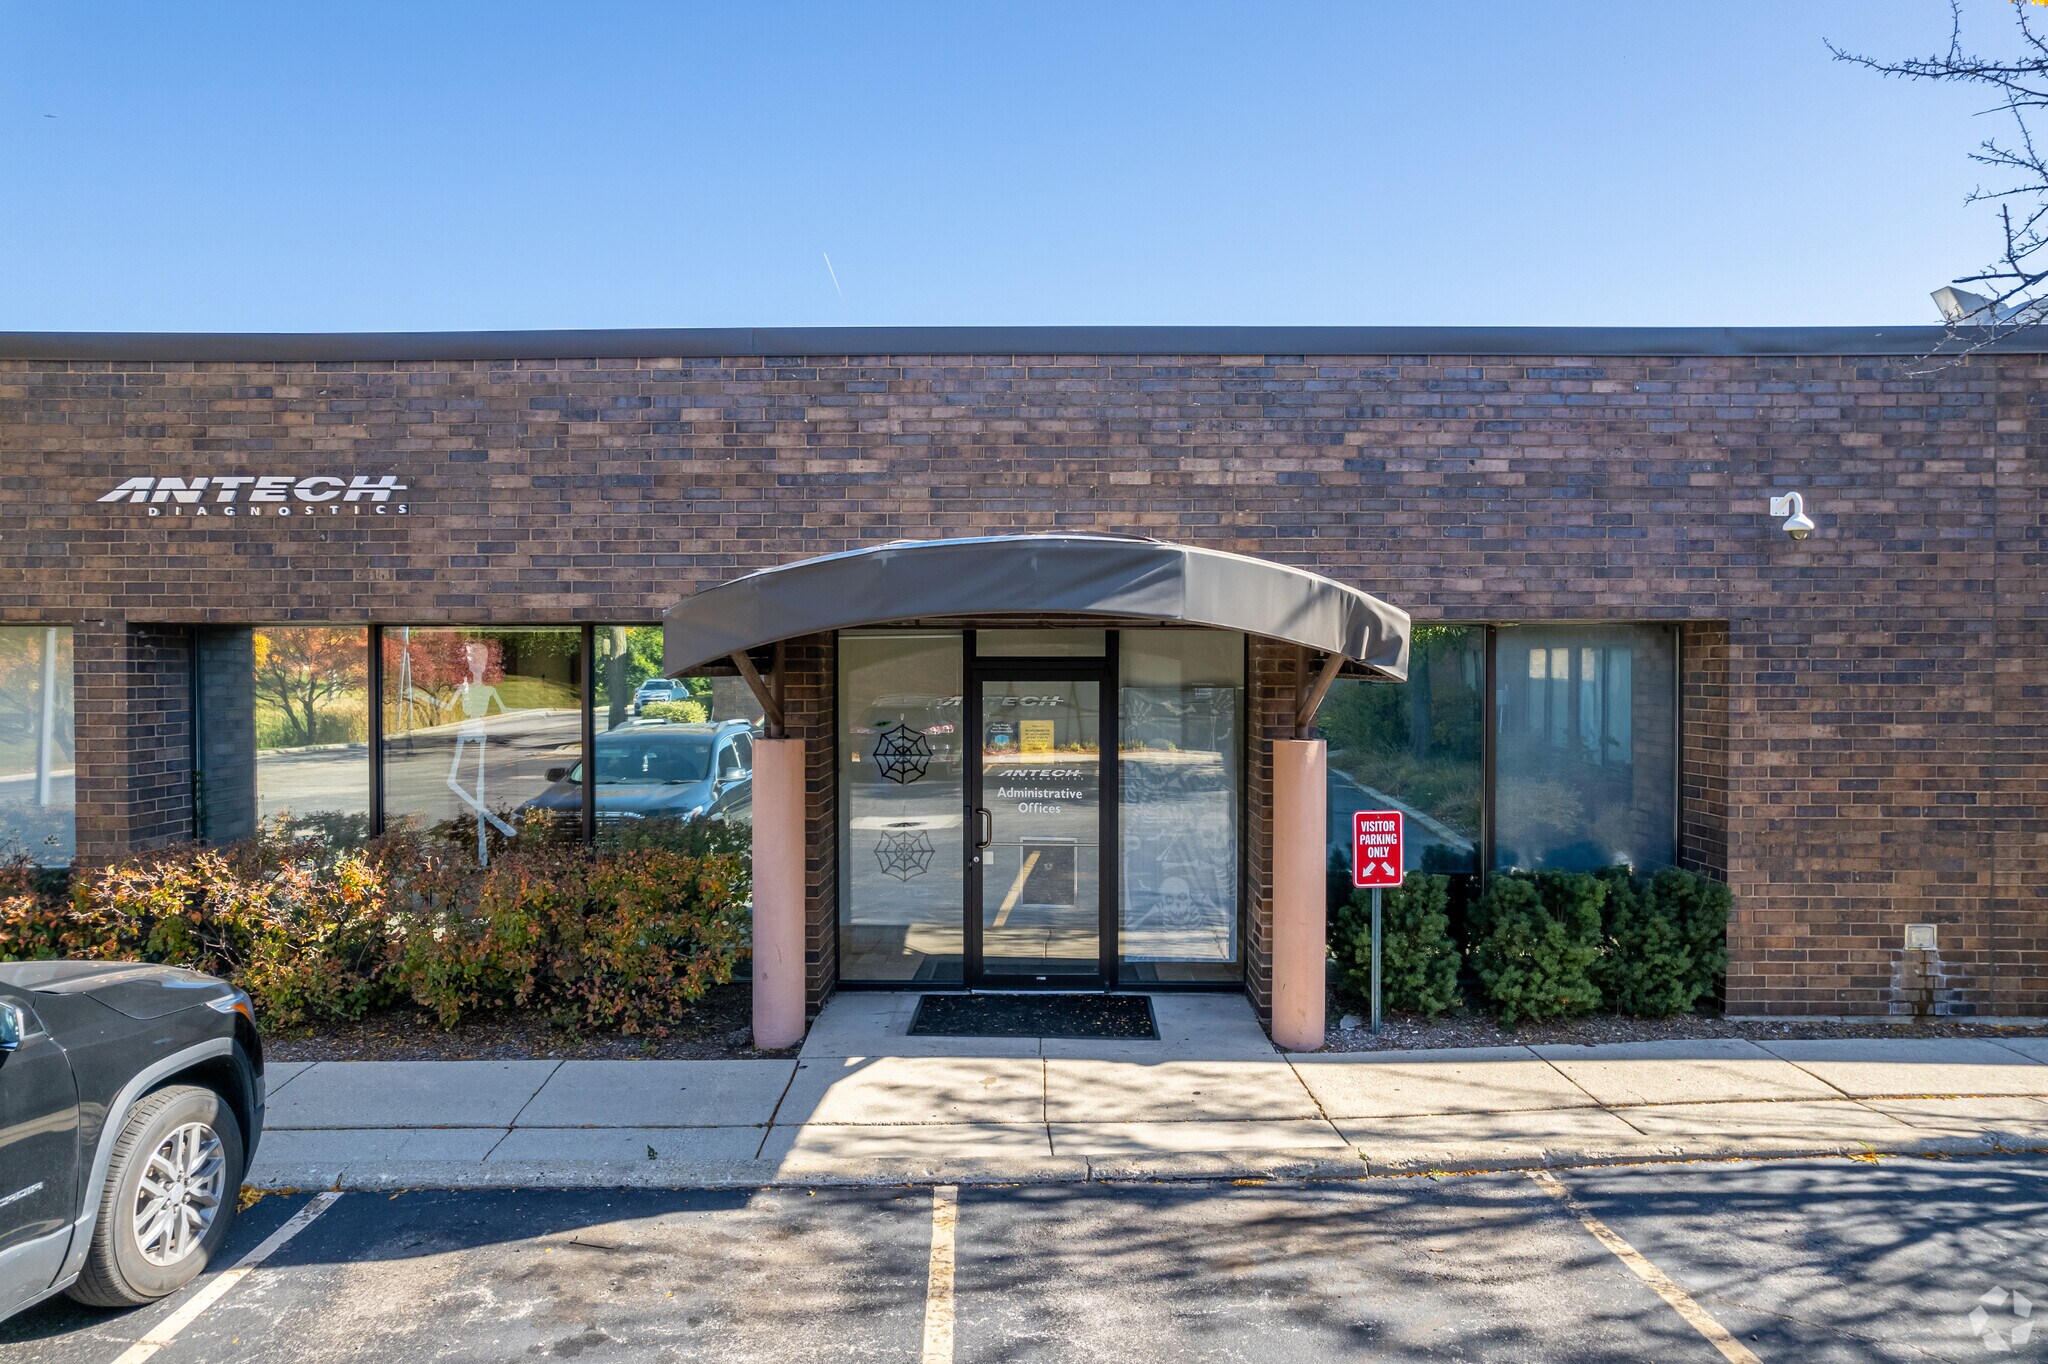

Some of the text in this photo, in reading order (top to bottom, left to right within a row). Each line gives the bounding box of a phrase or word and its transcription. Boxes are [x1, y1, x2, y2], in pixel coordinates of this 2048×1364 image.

[96, 476, 407, 503] ANTECH
[148, 504, 409, 517] DIAGNOSTICS
[942, 696, 1064, 706] ATECH
[998, 769, 1082, 777] ANTECH
[997, 787, 1083, 799] Administrative
[1018, 802, 1061, 814] Offices
[1361, 821, 1395, 832] VISITOR
[1360, 834, 1397, 845] PARKING
[1368, 847, 1389, 858] ONLY
